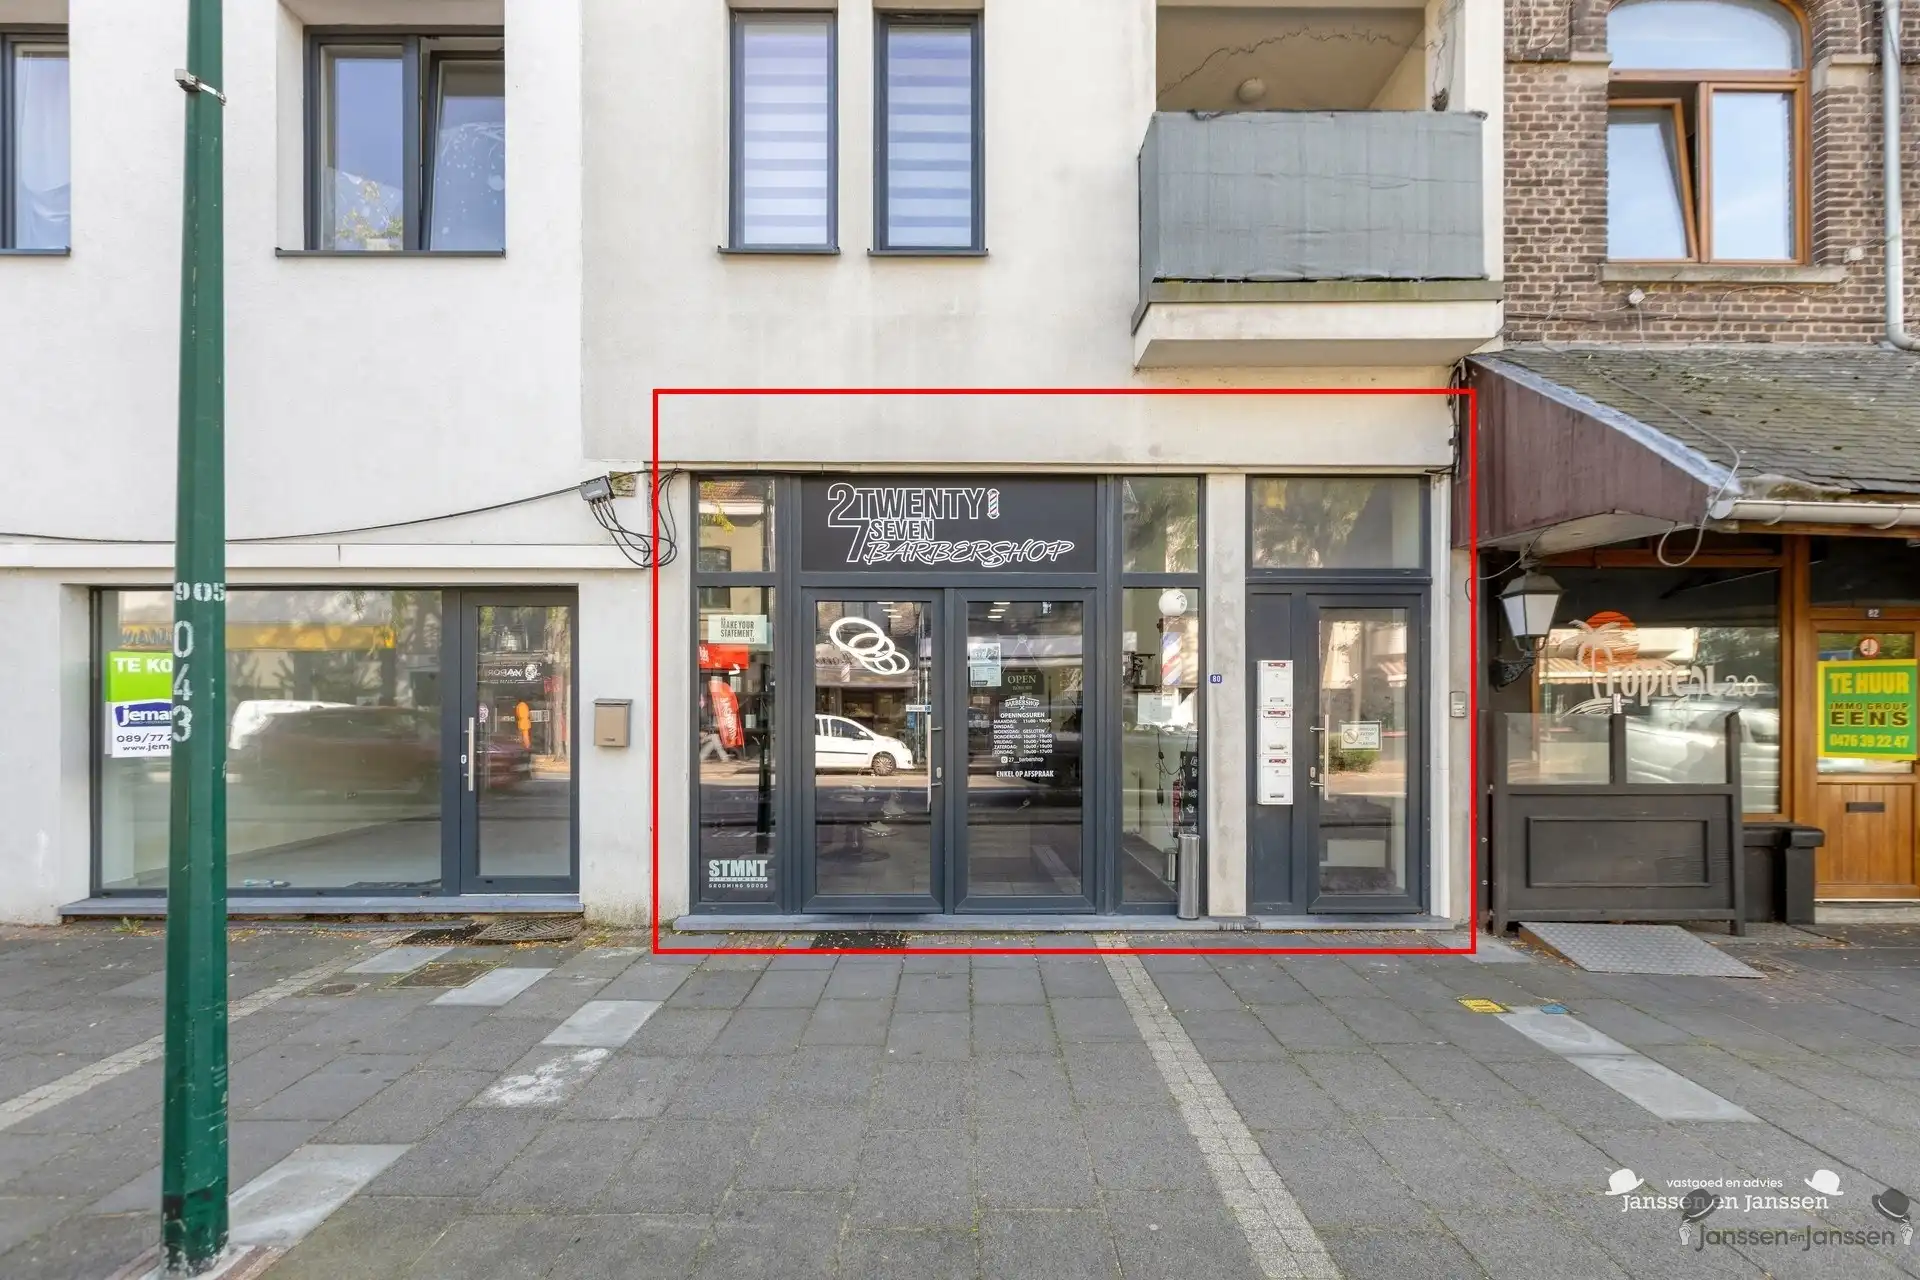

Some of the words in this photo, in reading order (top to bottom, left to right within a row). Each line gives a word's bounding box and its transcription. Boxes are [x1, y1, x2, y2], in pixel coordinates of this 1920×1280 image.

[855, 488, 986, 519] TWENTY
[869, 519, 934, 541] SEVEN
[864, 539, 1075, 568] BARBERSHOP
[174, 582, 226, 601] 905
[720, 620, 737, 629] MAKE
[738, 620, 755, 629] YOUR
[114, 657, 141, 673] TE
[147, 657, 173, 673] KO
[1008, 675, 1036, 683] OPEN
[1830, 672, 1852, 694] TE
[1856, 671, 1909, 694] HUUR
[1829, 702, 1864, 710] IMMO
[1867, 702, 1908, 710] GROUP
[1830, 711, 1909, 727] EENS
[116, 733, 164, 743] 089/77
[1829, 734, 1858, 747] 0476
[1860, 735, 1875, 747] 39
[122, 743, 172, 752] www.jem
[708, 859, 768, 877] STMNT
